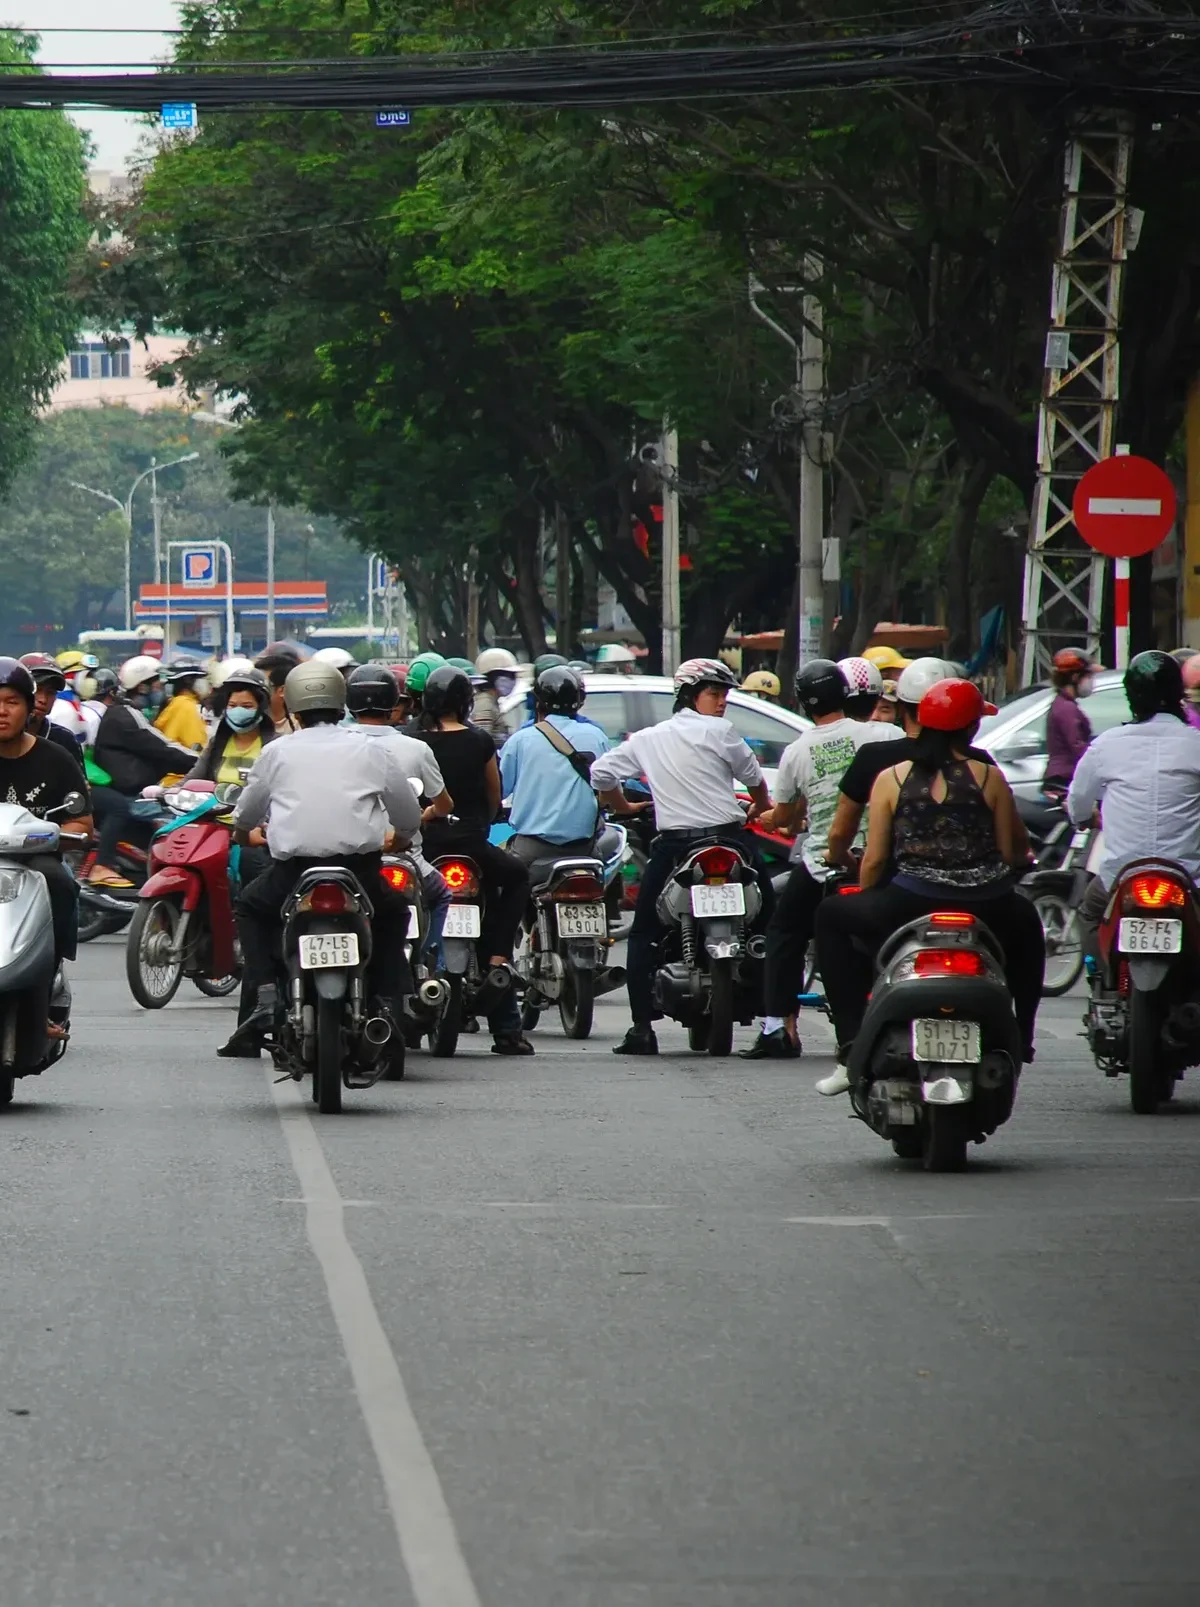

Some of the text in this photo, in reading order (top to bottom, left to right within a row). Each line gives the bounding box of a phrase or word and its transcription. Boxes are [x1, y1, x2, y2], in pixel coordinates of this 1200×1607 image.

[700, 886, 736, 900] 54-S5
[702, 900, 737, 913] 4433
[568, 920, 599, 933] 4904
[1130, 921, 1171, 935] 52-F4
[309, 936, 349, 950] 47-L5
[1129, 935, 1171, 950] 8646
[310, 950, 350, 966] 6919
[923, 1022, 970, 1040] 51-L3
[924, 1041, 969, 1060] 1071
